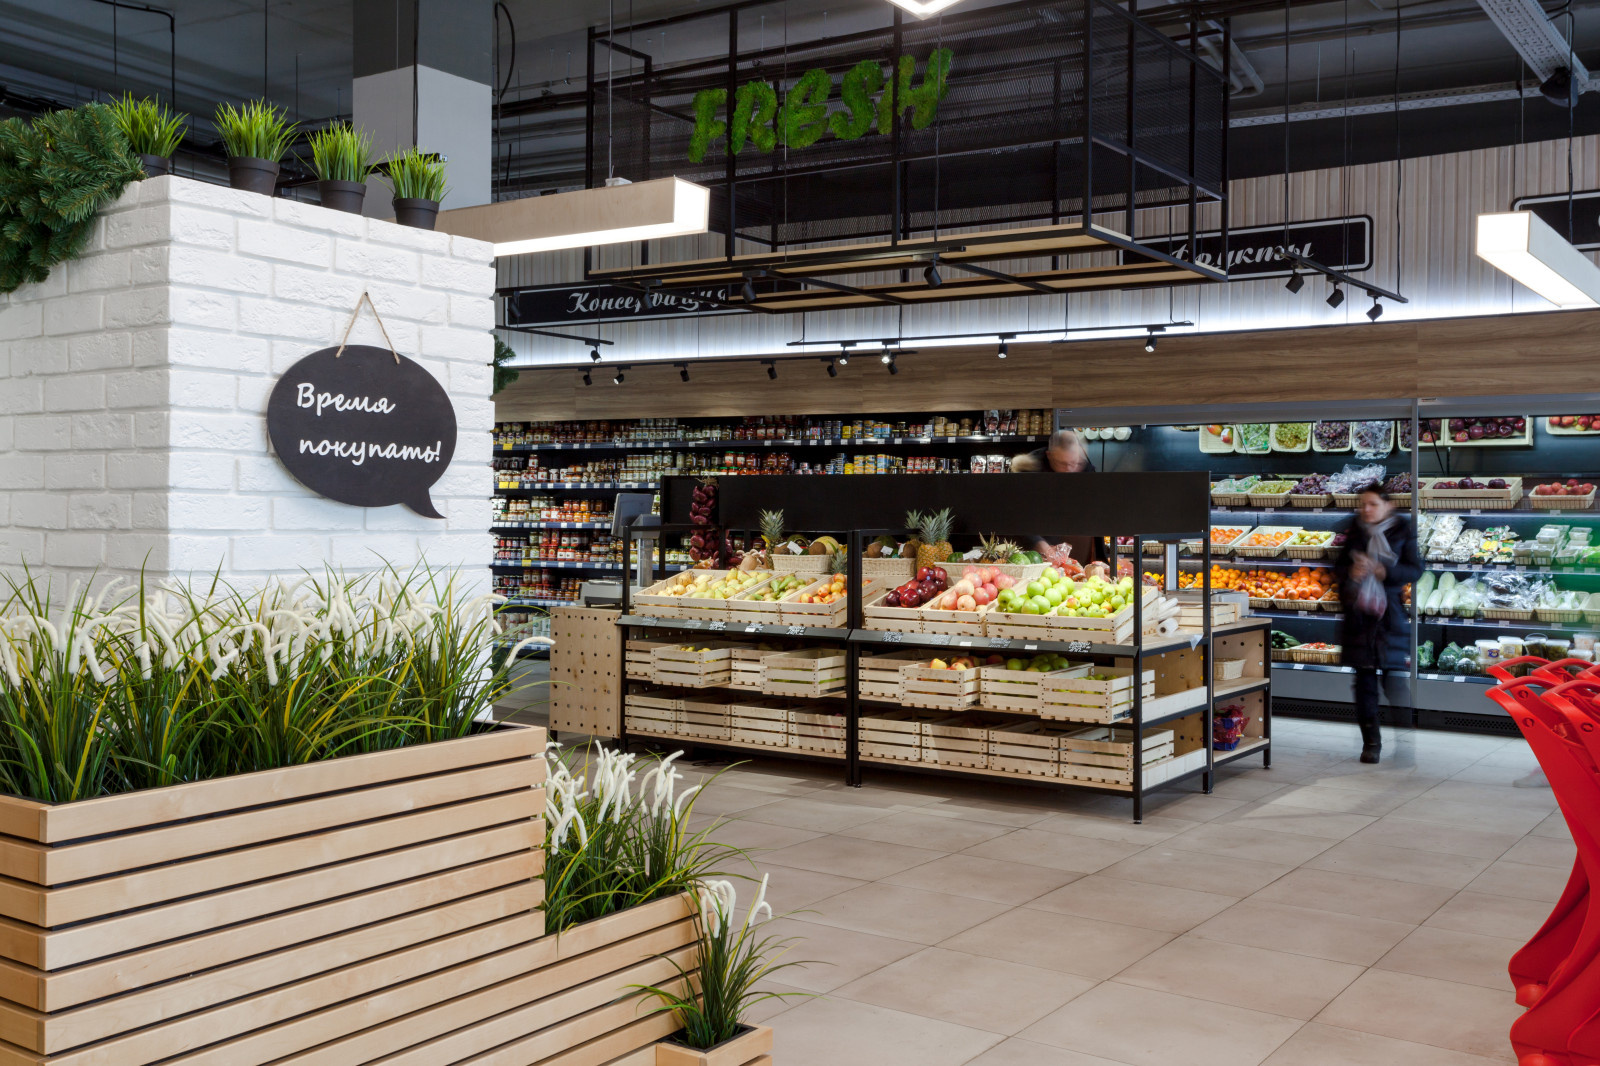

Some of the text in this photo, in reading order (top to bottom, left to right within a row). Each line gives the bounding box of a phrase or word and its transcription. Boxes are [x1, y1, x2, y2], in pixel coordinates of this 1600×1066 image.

[688, 48, 954, 163] FRESH
[297, 382, 397, 416] Время
[299, 439, 442, 466] покупать!
